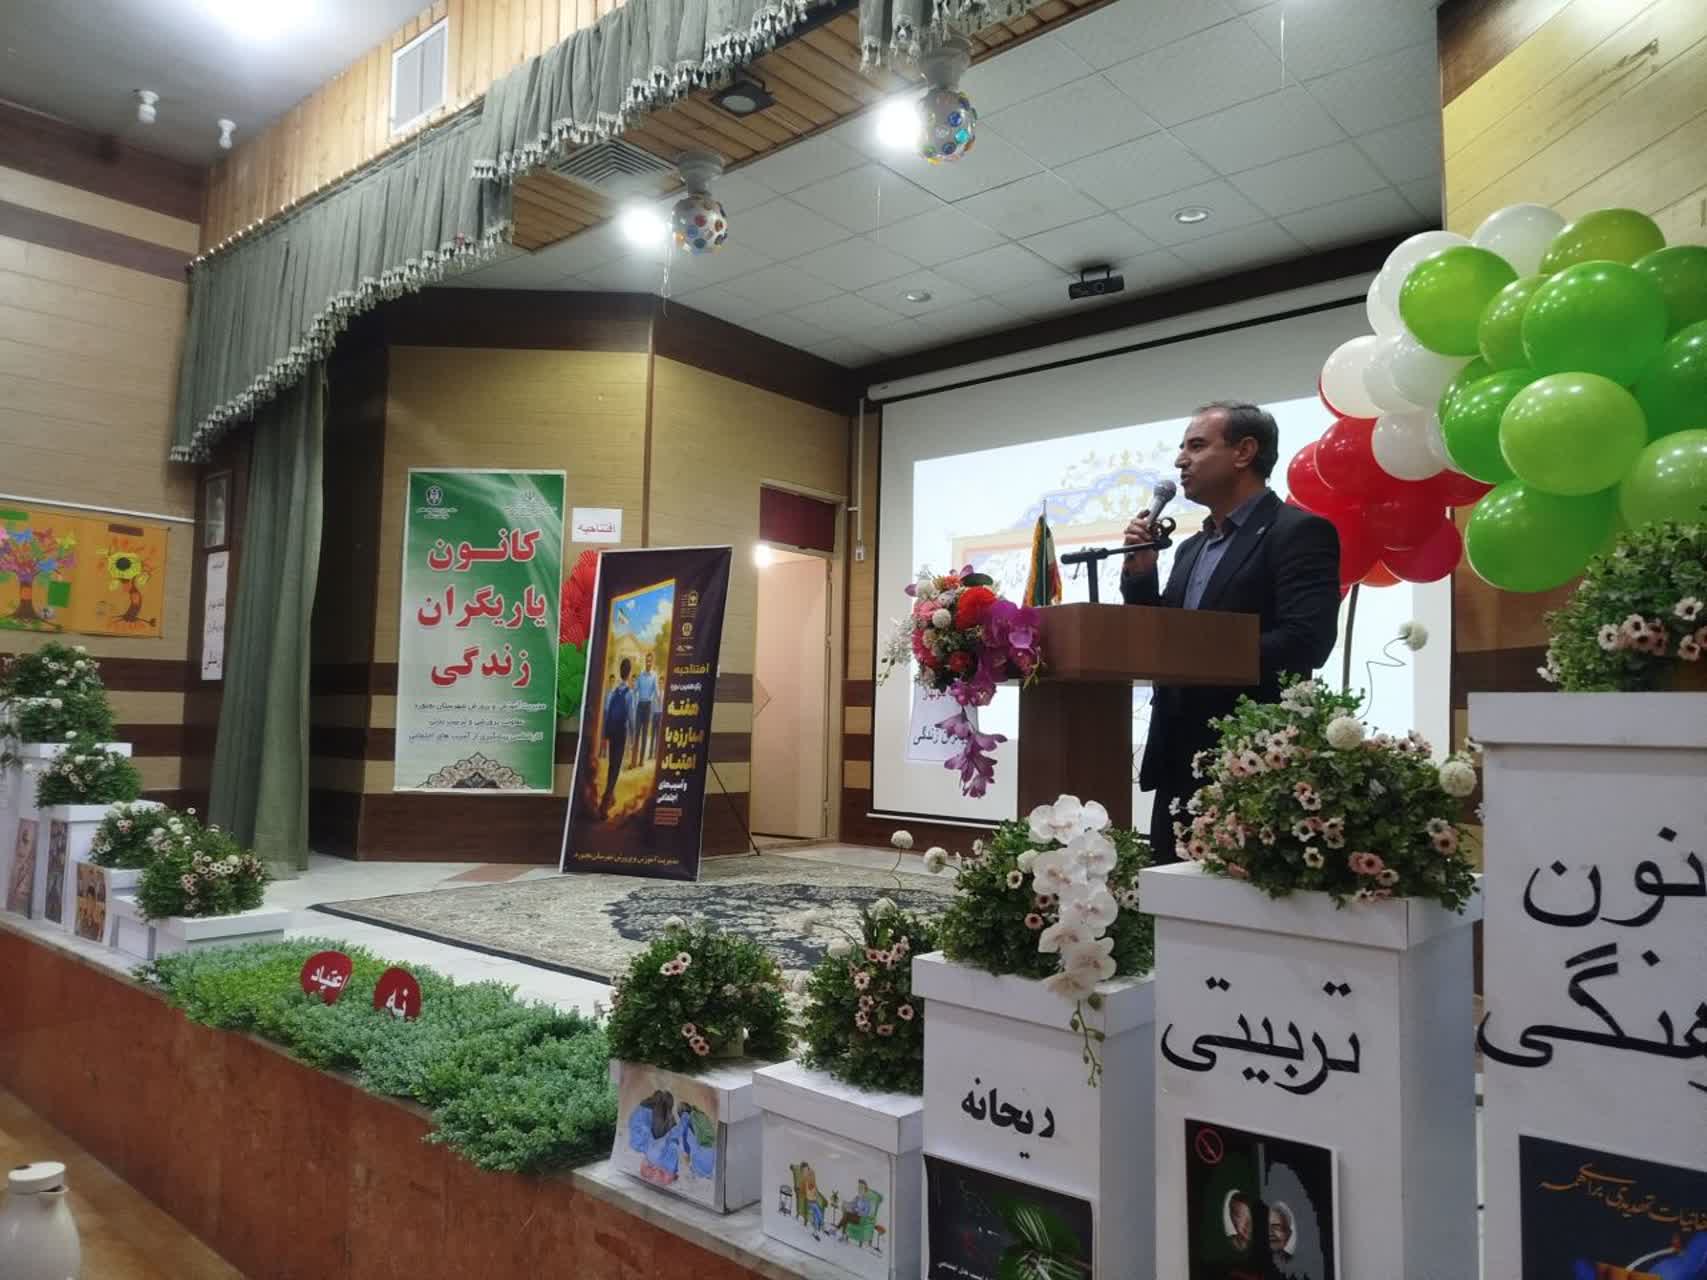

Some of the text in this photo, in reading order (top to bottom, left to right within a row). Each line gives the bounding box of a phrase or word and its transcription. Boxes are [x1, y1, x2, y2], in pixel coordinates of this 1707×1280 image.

[428, 528, 542, 571] کانون
[417, 584, 546, 628] یاریگران
[430, 644, 532, 687] زندگی
[673, 663, 710, 675] افتتاحیه
[667, 698, 699, 717] هفته
[664, 726, 704, 748] مبارزه با
[661, 753, 697, 776] اعتیاد
[1523, 826, 1707, 928] نون
[386, 988, 408, 1017] نه
[1161, 976, 1361, 1095] تربیتی
[961, 1077, 1056, 1159] ریحانه
